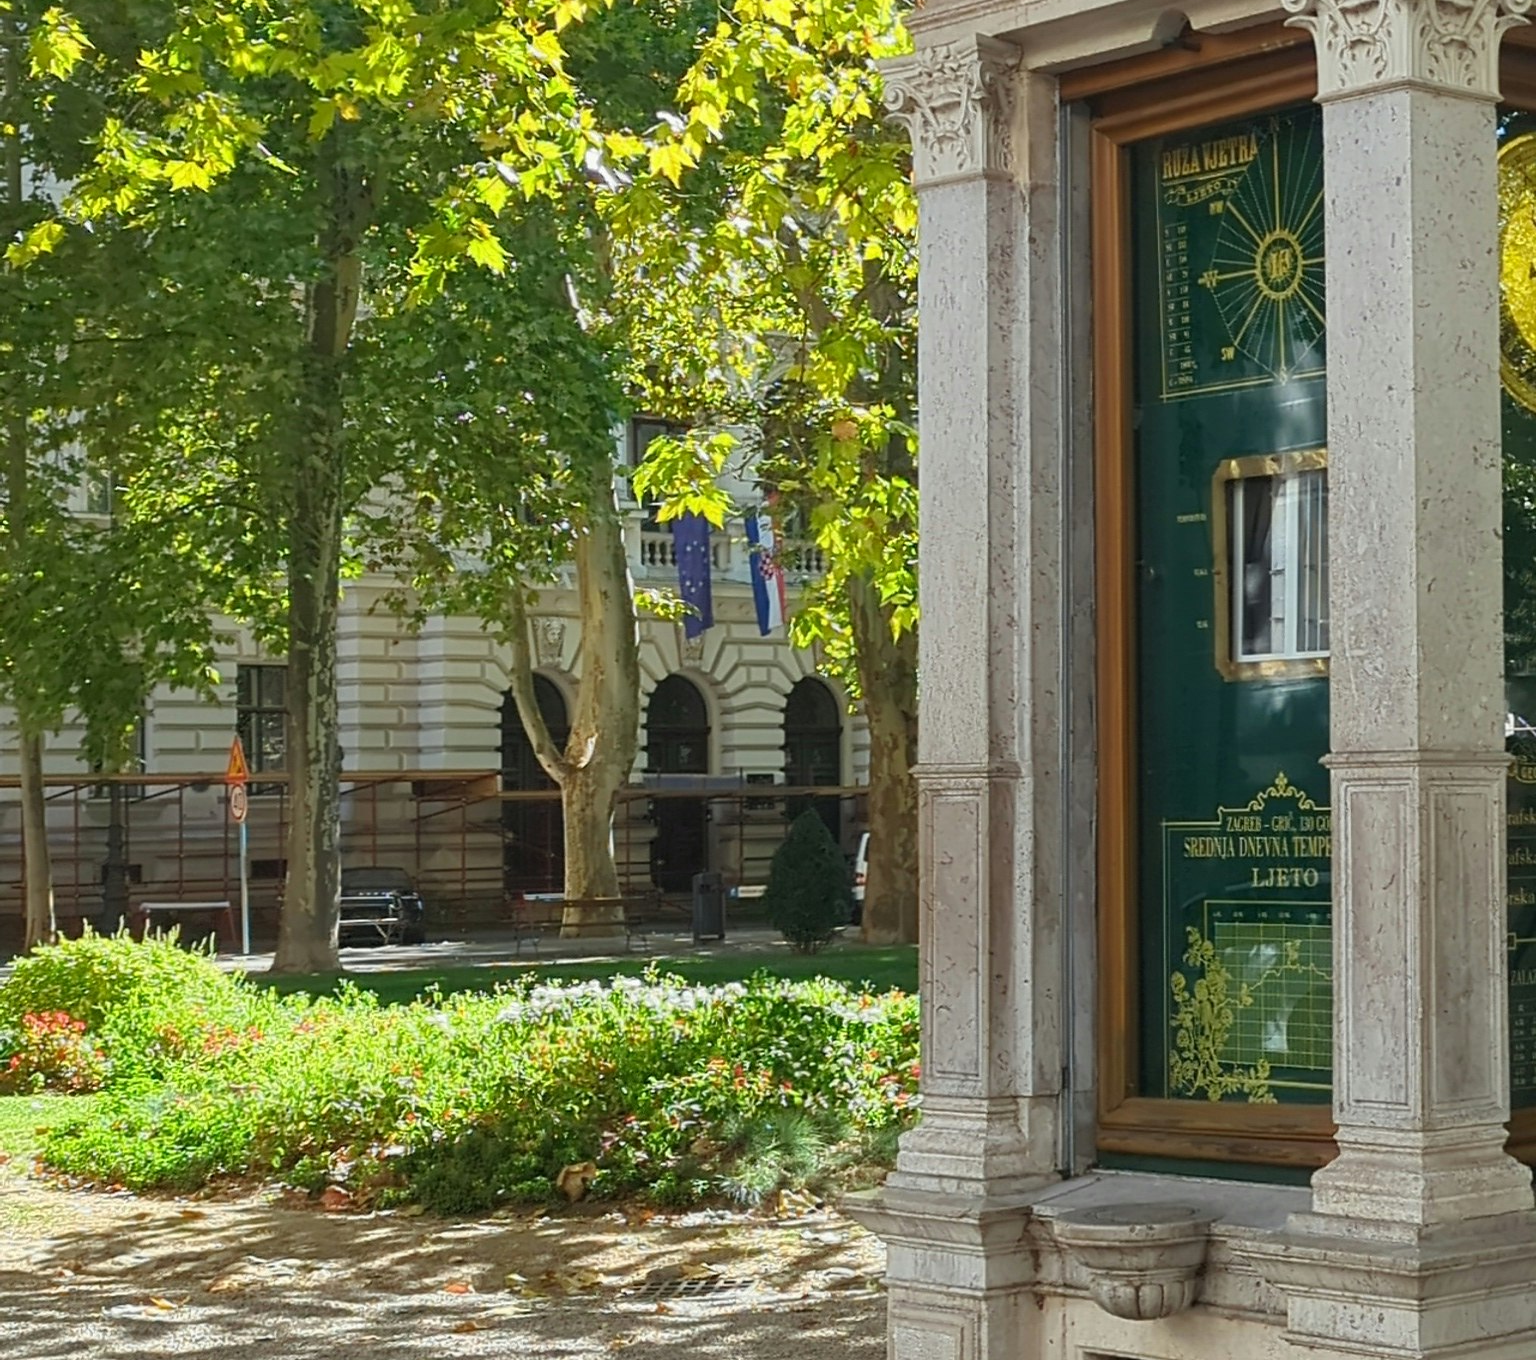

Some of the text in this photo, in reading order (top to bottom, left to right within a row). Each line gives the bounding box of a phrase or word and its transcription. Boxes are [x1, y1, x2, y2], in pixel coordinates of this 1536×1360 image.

[1162, 134, 1259, 179] RUŽA VJETRA
[1202, 269, 1219, 288] W
[1221, 346, 1236, 361] SW
[1226, 815, 1262, 832] ZAGREB
[1300, 815, 1315, 832] 130
[1184, 836, 1236, 859] SREDNJA
[1239, 836, 1289, 858] DNEVNA
[1251, 867, 1319, 888] LJETO
